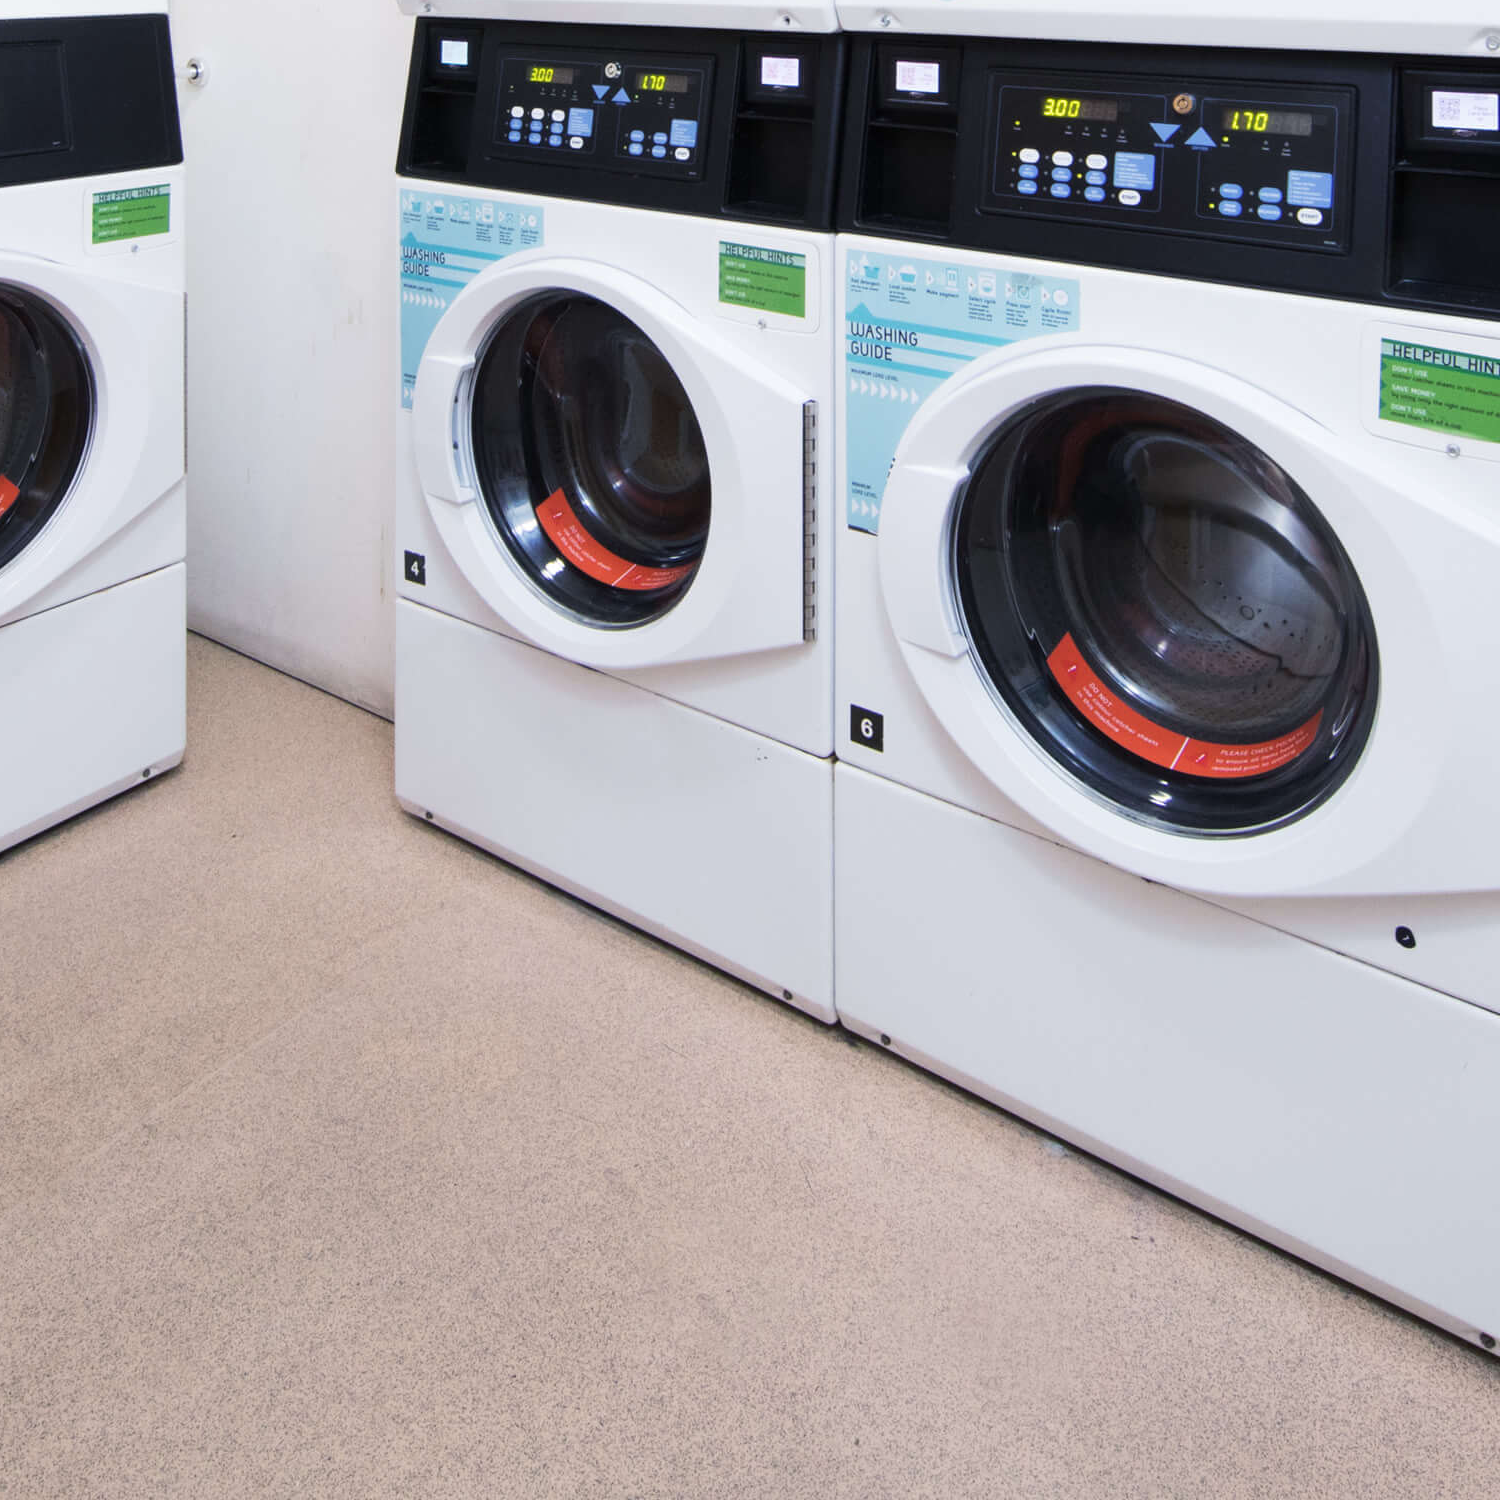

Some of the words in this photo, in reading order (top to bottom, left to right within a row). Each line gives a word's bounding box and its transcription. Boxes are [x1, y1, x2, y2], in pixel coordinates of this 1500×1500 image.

[530, 68, 554, 83] 3.00
[1043, 99, 1080, 118] 3.00
[1231, 112, 1268, 131] 1.70
[403, 246, 446, 265] WASHING
[725, 244, 763, 262] HELPFUL
[767, 251, 795, 265] HINTS
[403, 262, 429, 277] GUIDE
[850, 322, 918, 346] WASHING
[850, 341, 893, 362] GUIDE
[1393, 344, 1461, 368] HELPFUL
[1392, 384, 1409, 392] SAVE
[1412, 387, 1435, 397] MONEY
[410, 562, 419, 577] 4
[861, 718, 874, 739] 6
